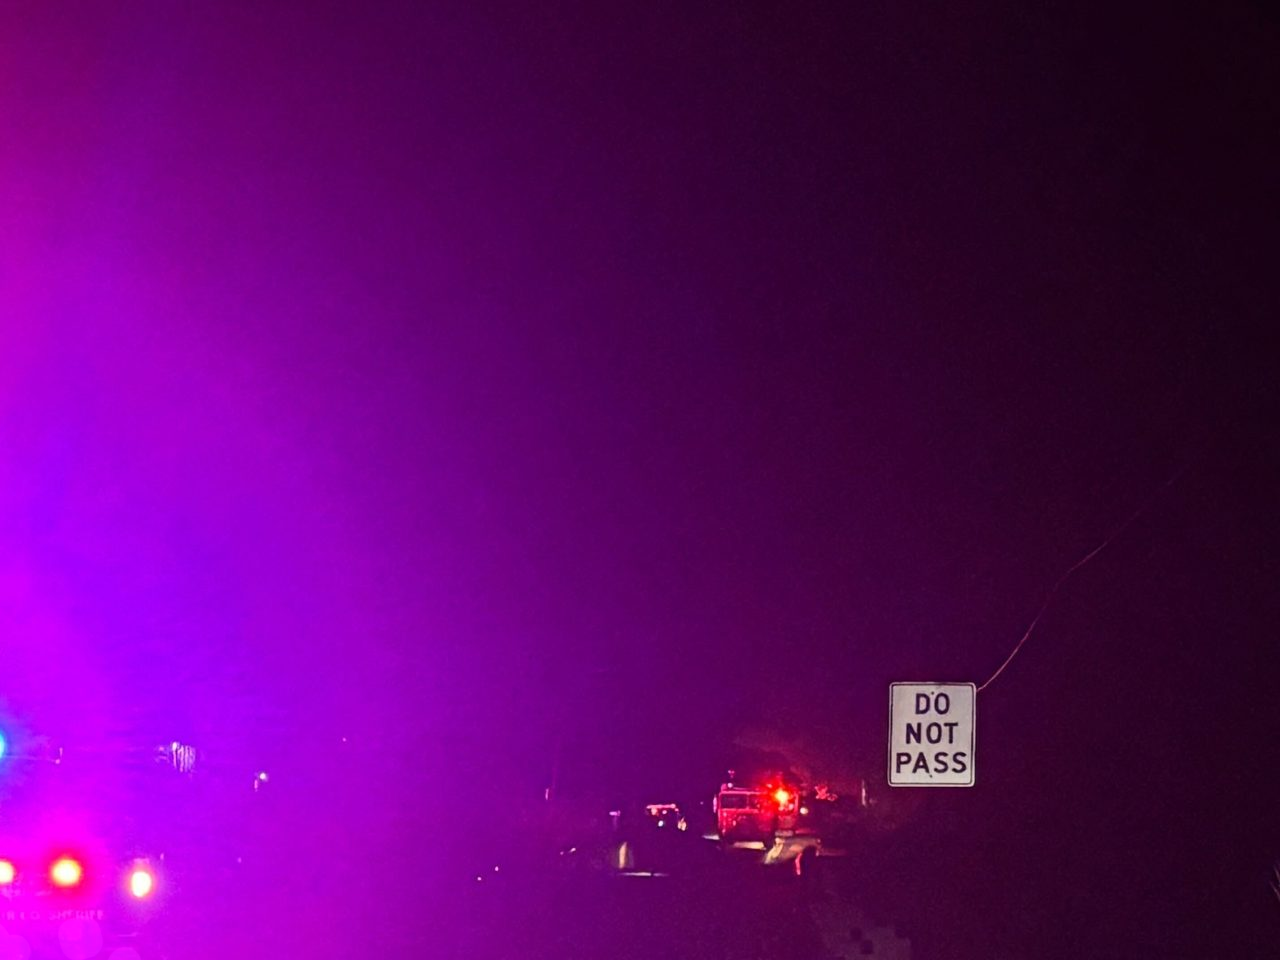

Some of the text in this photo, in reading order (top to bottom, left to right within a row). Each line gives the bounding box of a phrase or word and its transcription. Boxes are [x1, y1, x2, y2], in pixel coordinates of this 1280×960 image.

[915, 692, 951, 715] DO
[905, 721, 959, 745] NOT
[895, 751, 968, 774] PASS
